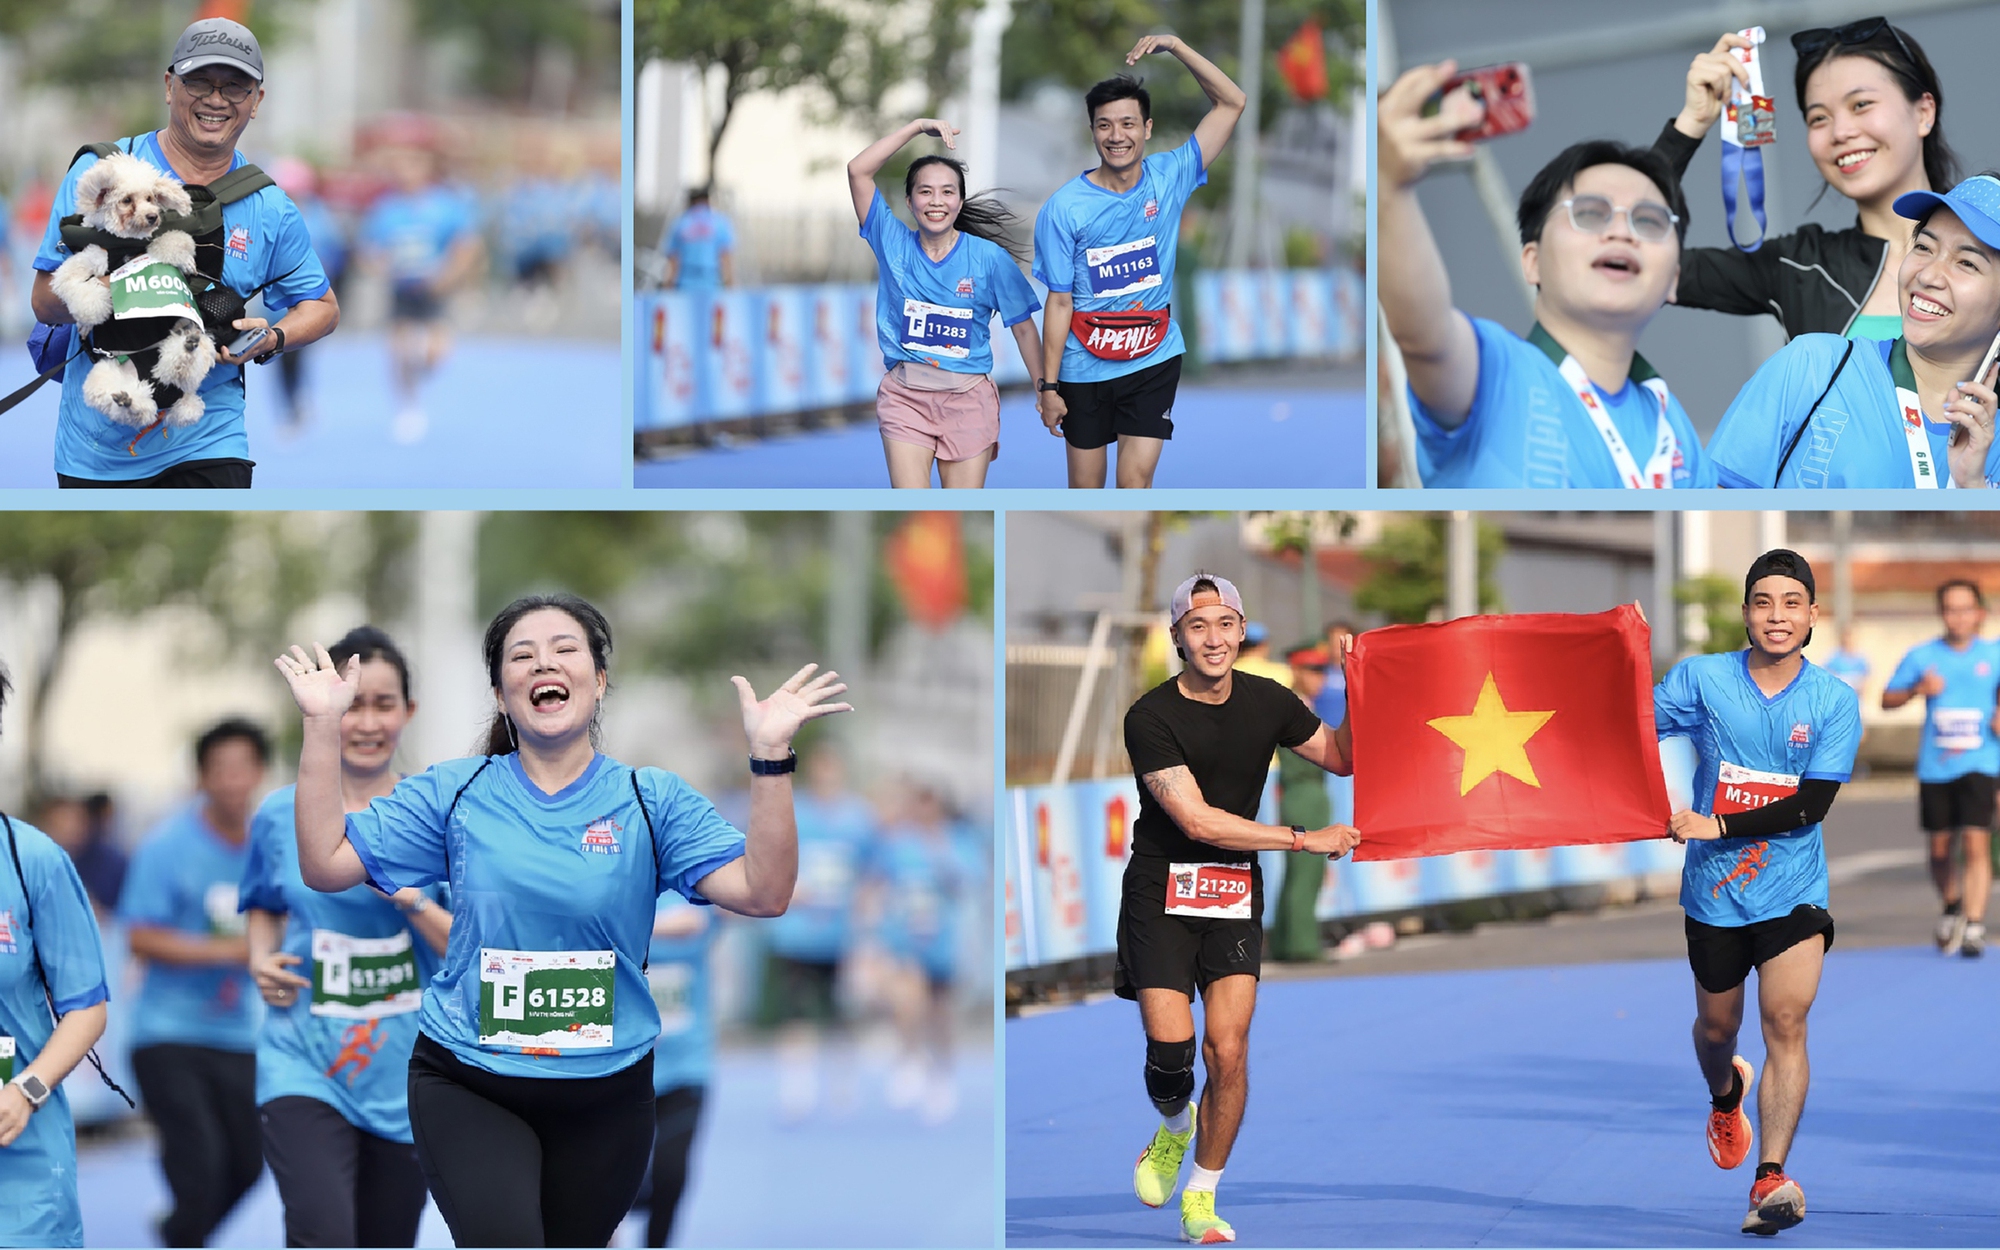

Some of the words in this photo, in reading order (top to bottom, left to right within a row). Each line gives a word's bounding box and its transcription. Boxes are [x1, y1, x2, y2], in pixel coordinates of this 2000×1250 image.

[187, 29, 253, 55] Titleist
[1098, 256, 1154, 279] M11163
[913, 318, 923, 331] F
[928, 322, 967, 339] 11283
[1918, 461, 1930, 476] KM
[1725, 785, 1784, 807] M211
[1199, 878, 1246, 894] 21220
[503, 986, 518, 1007] F
[529, 988, 606, 1008] 61528
